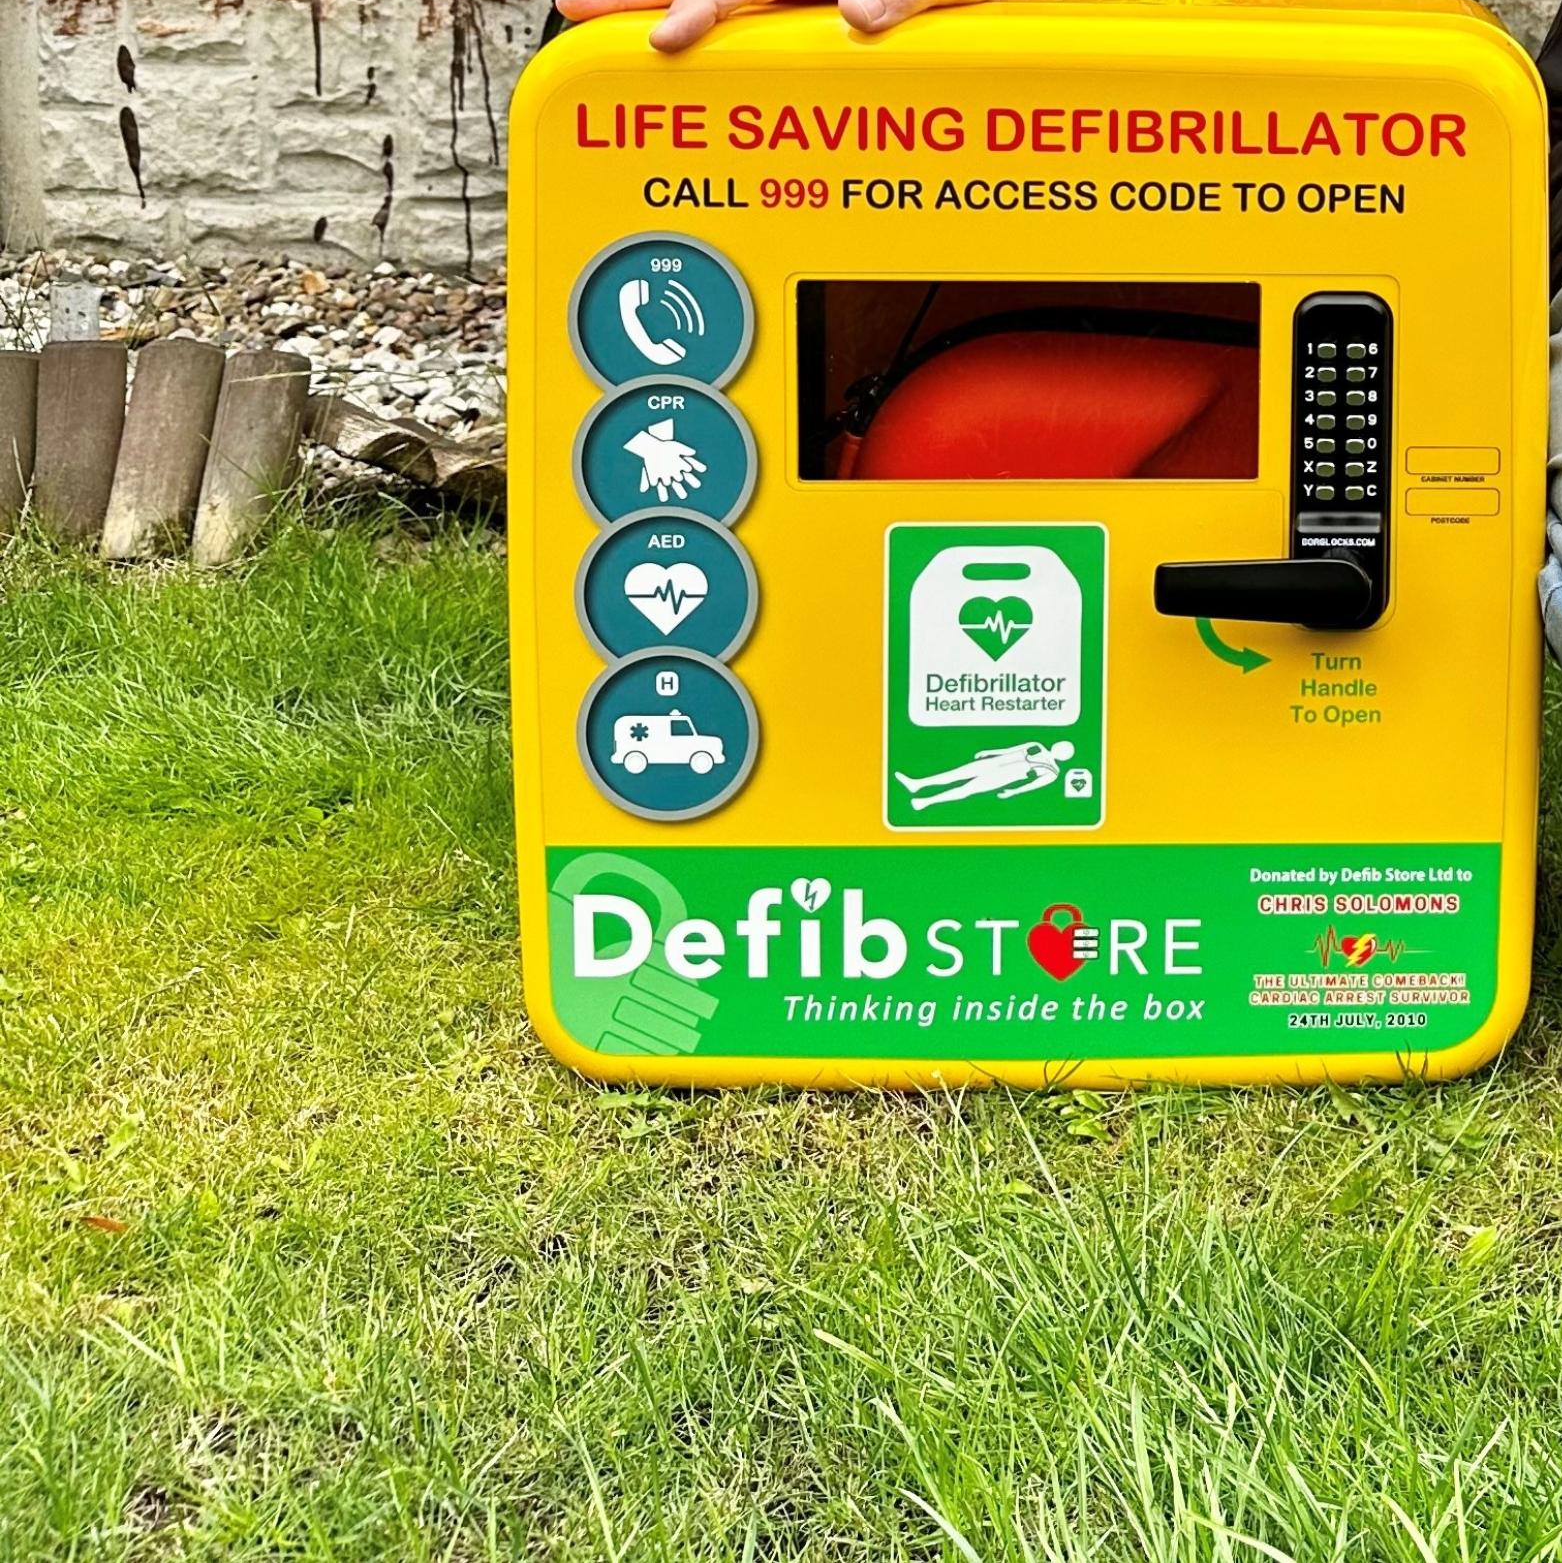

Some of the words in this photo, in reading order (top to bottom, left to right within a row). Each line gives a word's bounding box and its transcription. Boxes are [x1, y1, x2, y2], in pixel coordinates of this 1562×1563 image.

[577, 103, 707, 149] LIFE
[727, 104, 966, 152] SAVING
[985, 107, 1468, 157] DEFIBRILLATOR
[643, 176, 750, 210] CALL
[758, 177, 830, 210] 999
[841, 178, 923, 211] FOR
[933, 178, 1098, 212] ACCESS
[1108, 180, 1223, 214] CODE
[1232, 181, 1285, 214] TO
[1296, 182, 1406, 215] OPEN
[650, 258, 682, 273] 999
[1307, 343, 1313, 355] 1
[1368, 343, 1378, 355] 6
[1305, 367, 1315, 379] 2
[1368, 367, 1378, 379] 7
[647, 395, 685, 411] CPR
[1304, 390, 1314, 402] 3
[1368, 390, 1378, 402] 8
[1304, 414, 1314, 426] 4
[1368, 414, 1378, 426] 9
[1304, 438, 1314, 450] 5
[1367, 438, 1377, 450] 0
[1304, 461, 1314, 473] X
[1367, 461, 1377, 473] Z
[1304, 485, 1314, 497] Y
[1367, 485, 1377, 497] C
[647, 534, 685, 549] AED
[1312, 652, 1362, 671] Turn
[660, 676, 673, 691] H
[925, 673, 1066, 694] Defibrillator
[1301, 678, 1378, 697] Handle
[925, 695, 976, 712] Heart
[981, 695, 1066, 712] Restarter
[1290, 705, 1318, 724] To
[1323, 705, 1382, 727] Open
[1250, 867, 1316, 882] Donated
[1319, 867, 1337, 886] by
[1341, 867, 1382, 882] Defib
[1385, 868, 1426, 882] Store
[1429, 867, 1454, 882] Ltd
[1456, 869, 1472, 882] to
[1259, 895, 1326, 913] CHRIS
[1335, 895, 1459, 913] SOLOMONS
[573, 877, 908, 979] Defib
[1255, 975, 1283, 987] THE
[1290, 975, 1367, 988] ULTIMATE
[1250, 992, 1319, 1004] CARDIAC
[1325, 991, 1385, 1004] ARREST
[1390, 991, 1470, 1004] SURVIVOR
[783, 995, 938, 1028] Thinking
[952, 994, 1058, 1022] inside
[1071, 994, 1127, 1021] the
[1143, 994, 1205, 1021] box
[1289, 1014, 1329, 1026] 24TH
[1336, 1014, 1381, 1028] JULY,
[1387, 1014, 1427, 1026] 2010
